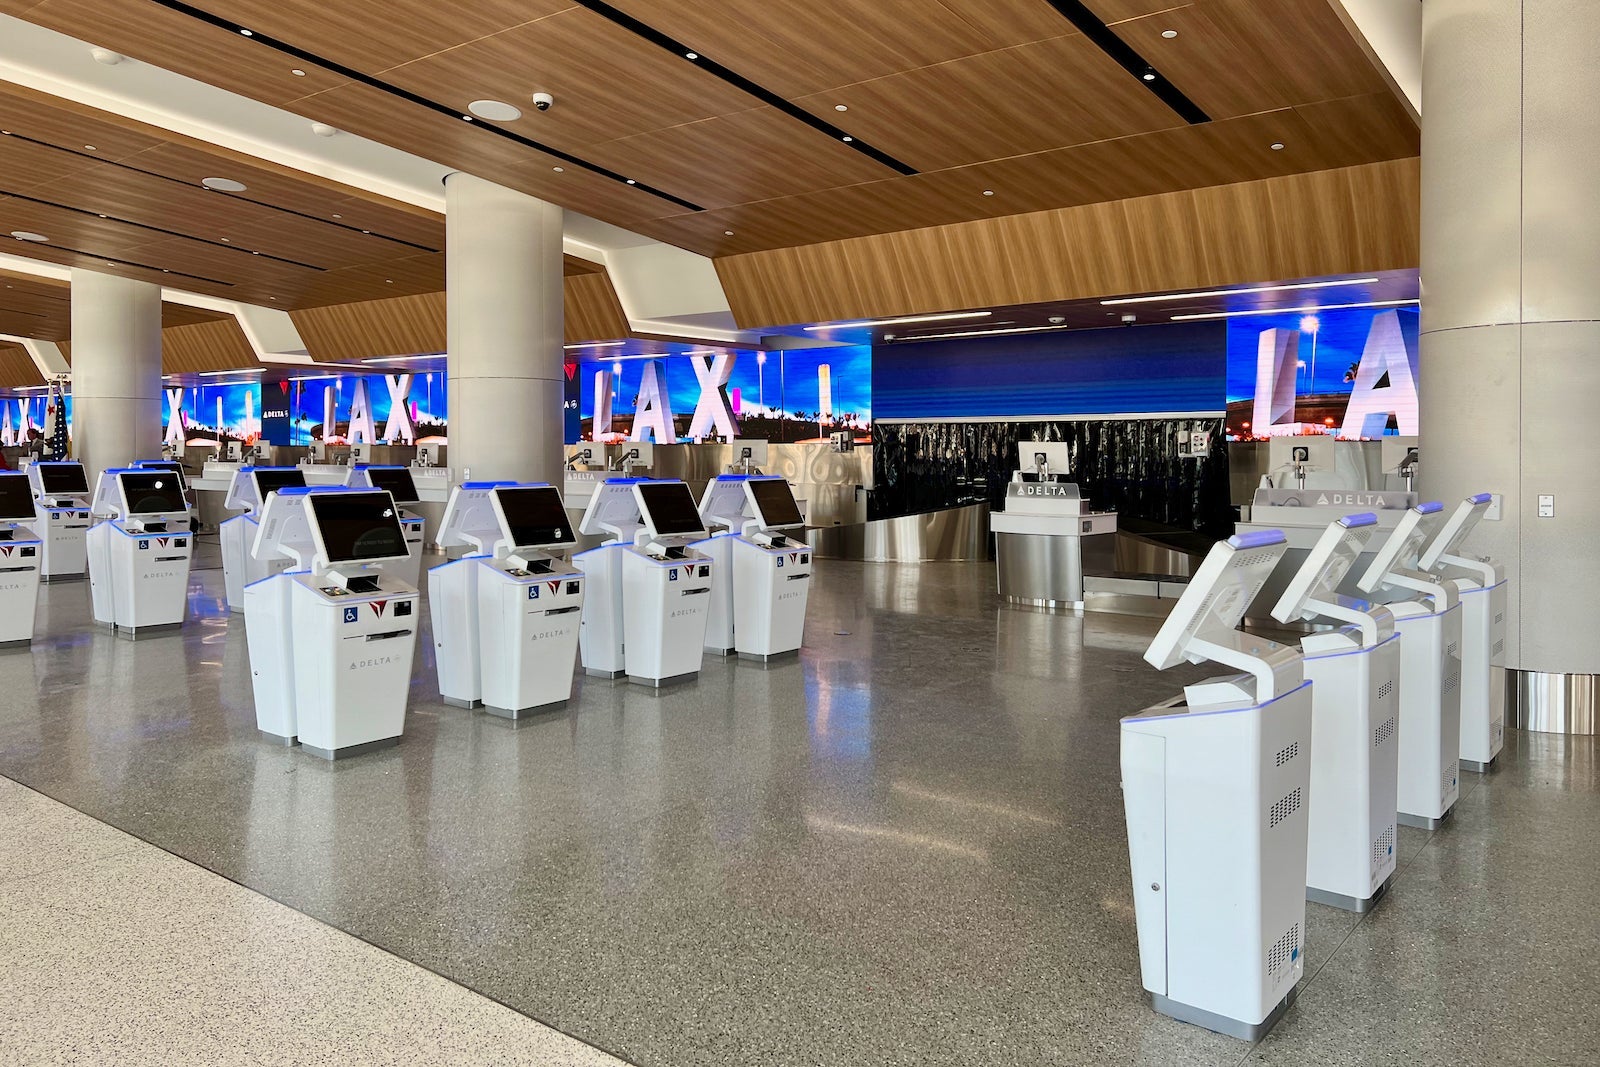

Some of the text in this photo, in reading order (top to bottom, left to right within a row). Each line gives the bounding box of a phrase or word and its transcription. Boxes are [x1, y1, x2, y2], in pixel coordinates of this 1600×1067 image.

[593, 354, 741, 444] LAX
[267, 410, 284, 418] DELTA
[323, 374, 415, 445] LAX
[572, 472, 595, 481] DELTA
[1027, 486, 1066, 496] DELTA
[1333, 494, 1386, 506] DELTA
[676, 608, 697, 617] DELTA
[539, 629, 563, 639] DELTA
[360, 656, 391, 668] DELTA
